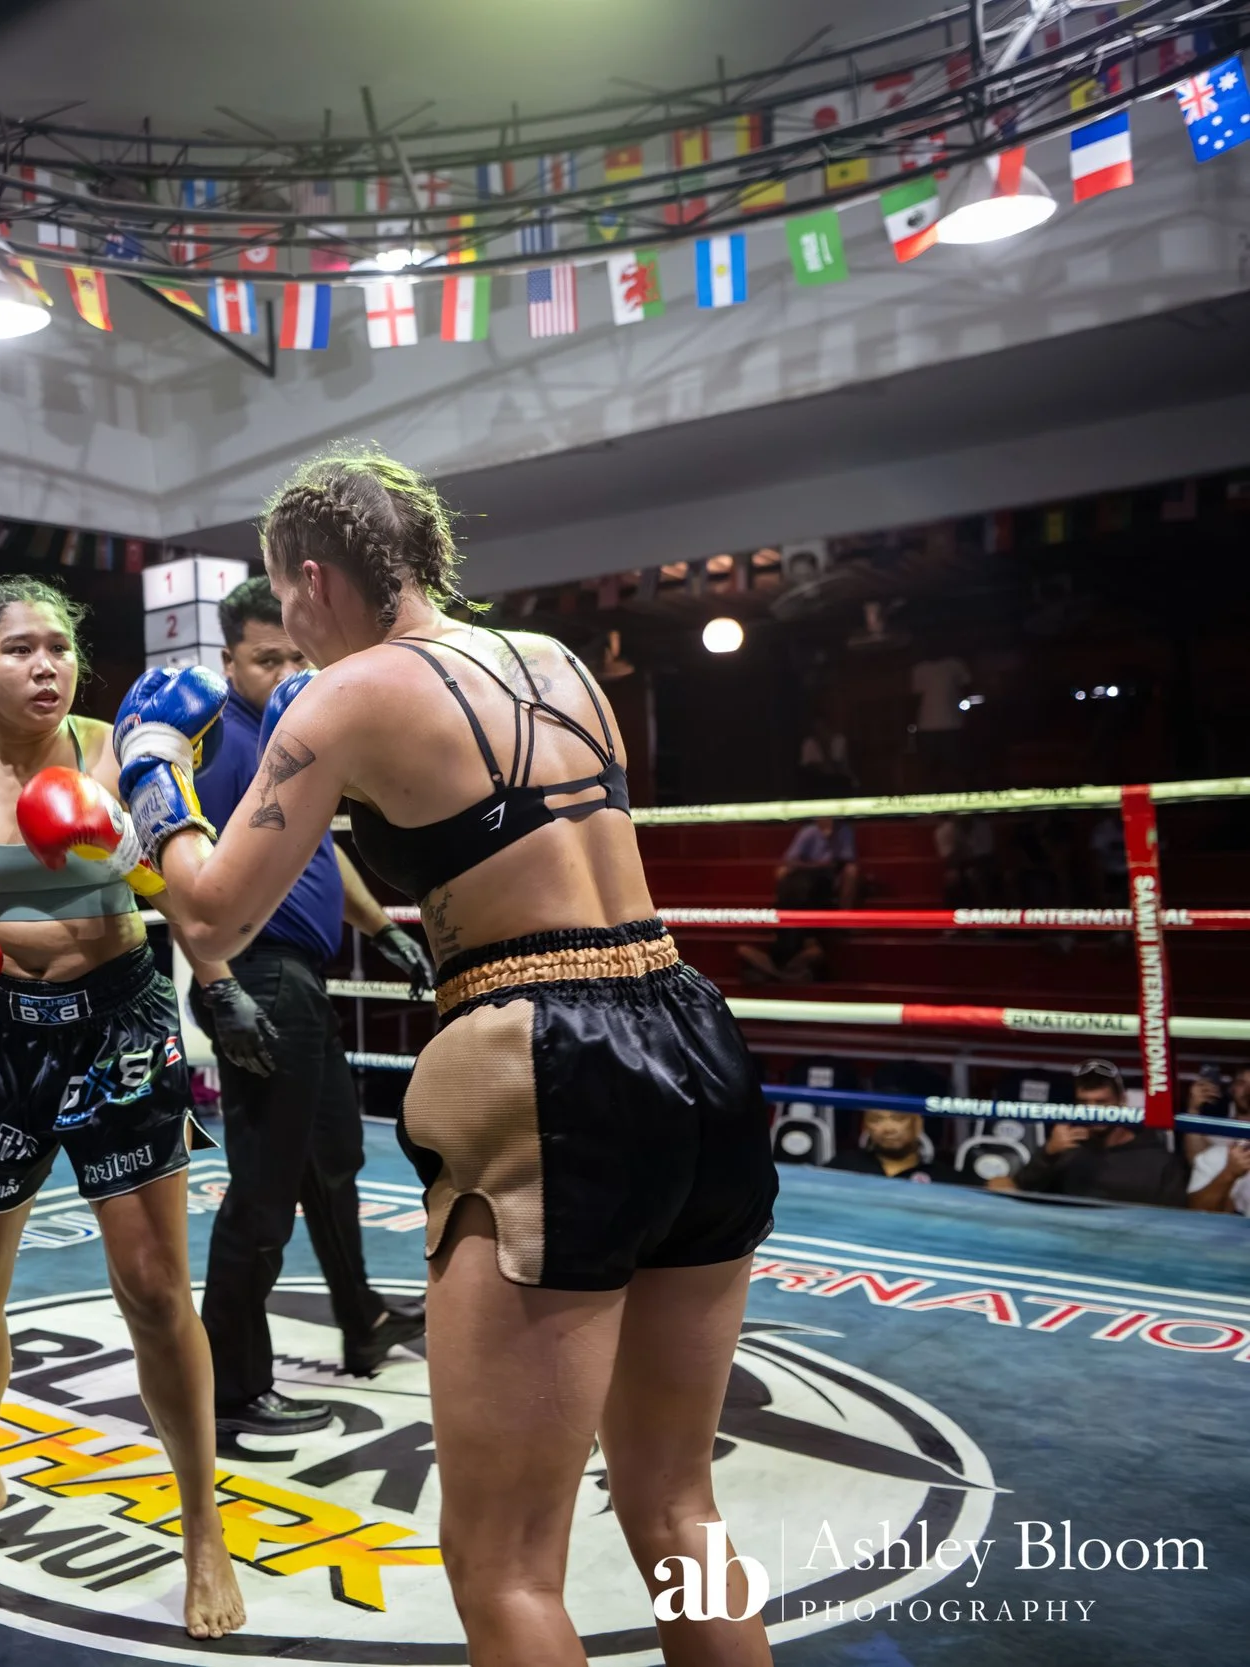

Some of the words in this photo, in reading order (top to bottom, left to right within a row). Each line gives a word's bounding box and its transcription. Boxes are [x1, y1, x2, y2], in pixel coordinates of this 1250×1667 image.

[165, 571, 173, 594] 1
[218, 571, 225, 593] 1
[166, 613, 178, 639] 2
[953, 908, 1022, 925] SAMUI
[1024, 908, 1193, 926] INTERNATIAL
[1134, 875, 1158, 942] SAMUI
[1011, 1014, 1130, 1032] RNATIONAL
[1139, 945, 1168, 1096] INTERNATIONAL
[925, 1095, 994, 1117] SAMUI
[996, 1100, 1146, 1125] INTERNATIONA
